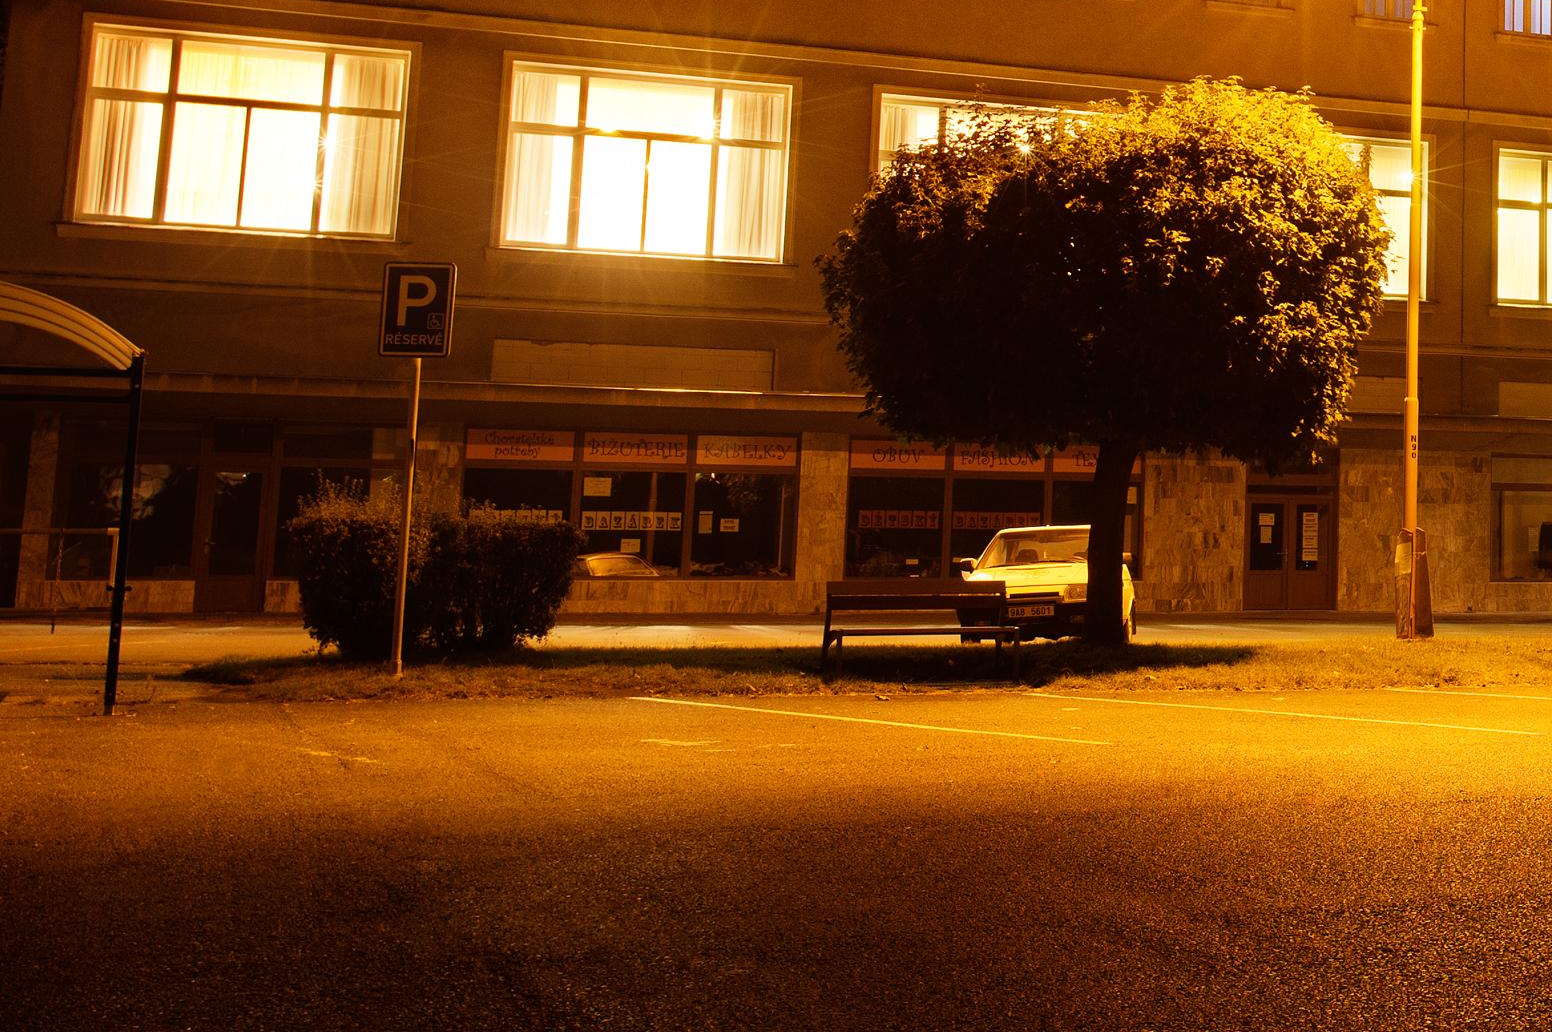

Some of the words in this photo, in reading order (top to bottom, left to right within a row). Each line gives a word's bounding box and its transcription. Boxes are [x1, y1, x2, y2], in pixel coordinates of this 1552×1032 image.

[397, 274, 438, 327] P
[703, 442, 792, 460] KABELKY
[873, 446, 924, 464] OBUV
[583, 513, 681, 529] BAZÁREK
